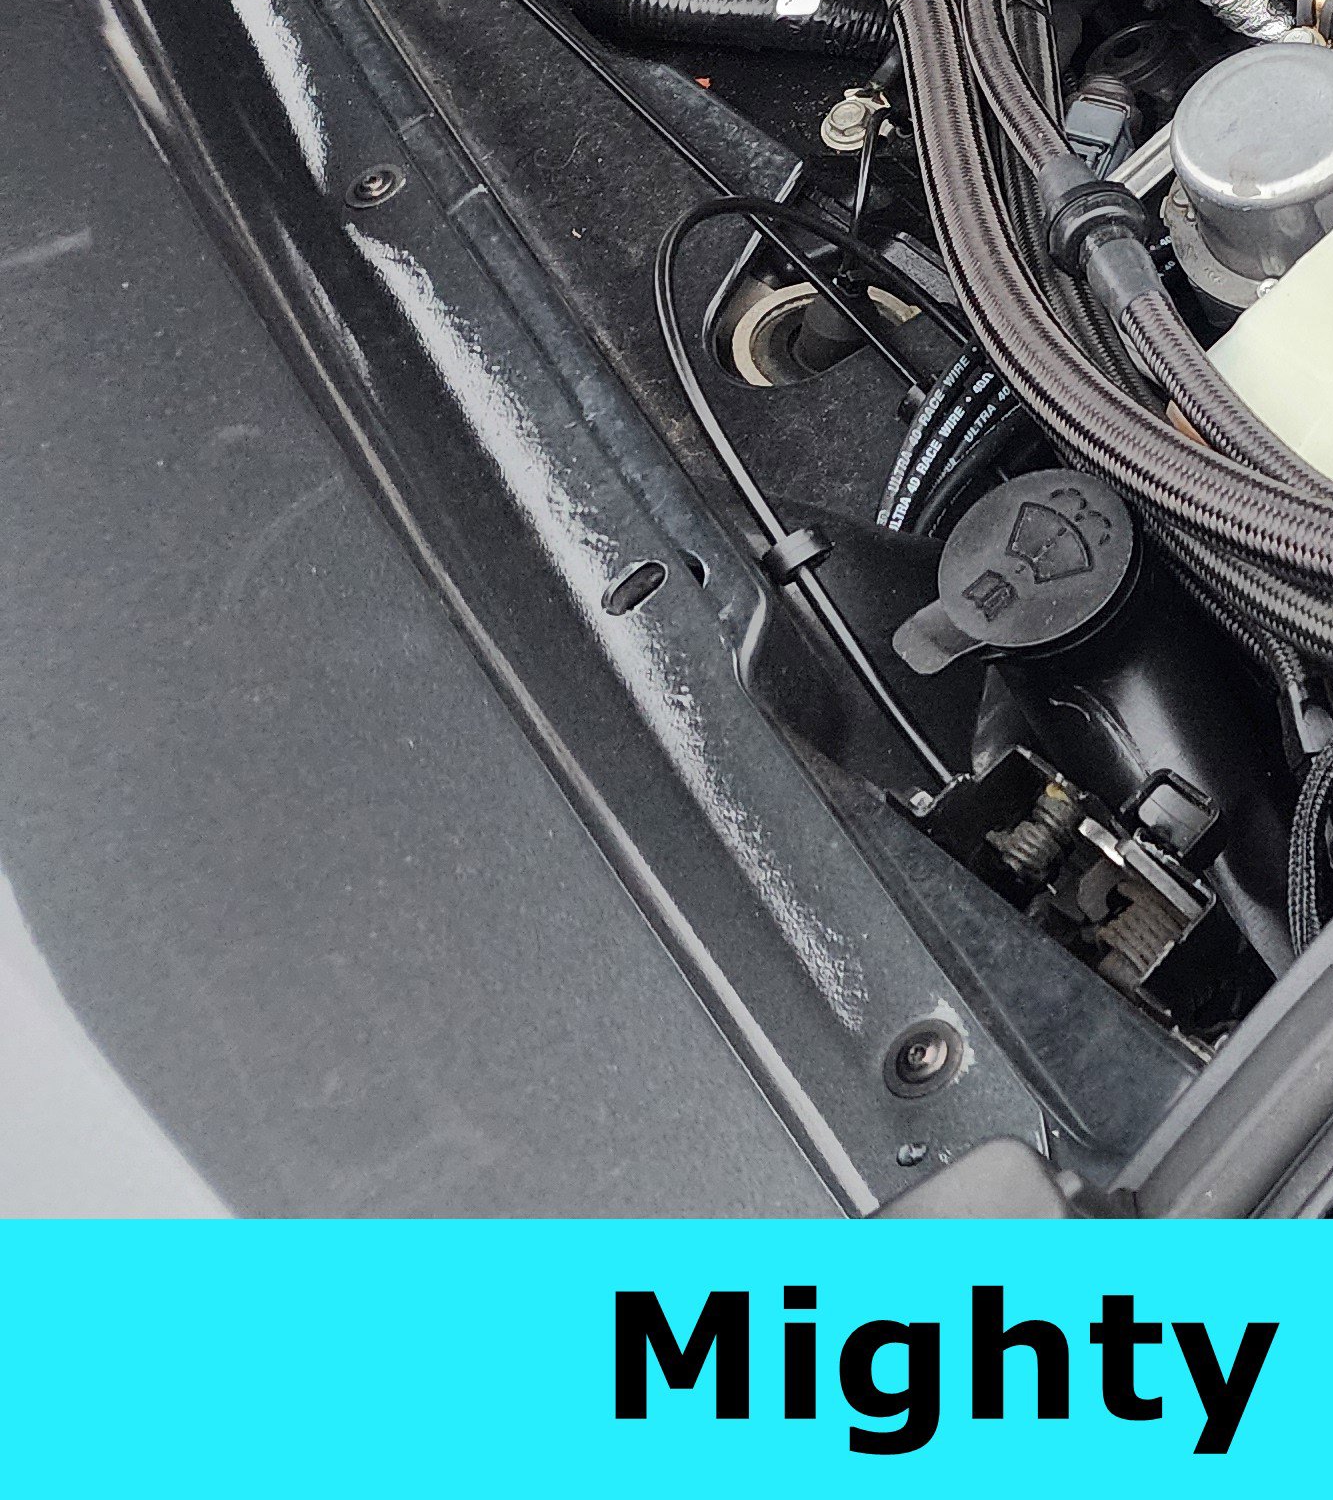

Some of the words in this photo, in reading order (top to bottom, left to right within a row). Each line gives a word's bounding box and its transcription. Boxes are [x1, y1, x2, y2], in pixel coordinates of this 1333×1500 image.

[887, 450, 913, 493] ULTRA
[908, 429, 923, 447] 40
[918, 388, 945, 427] RACE
[942, 354, 970, 388] WIRE
[906, 476, 921, 494] 40
[915, 438, 943, 476] RACE
[938, 405, 966, 438] WIRE
[963, 403, 997, 443] ULTRA
